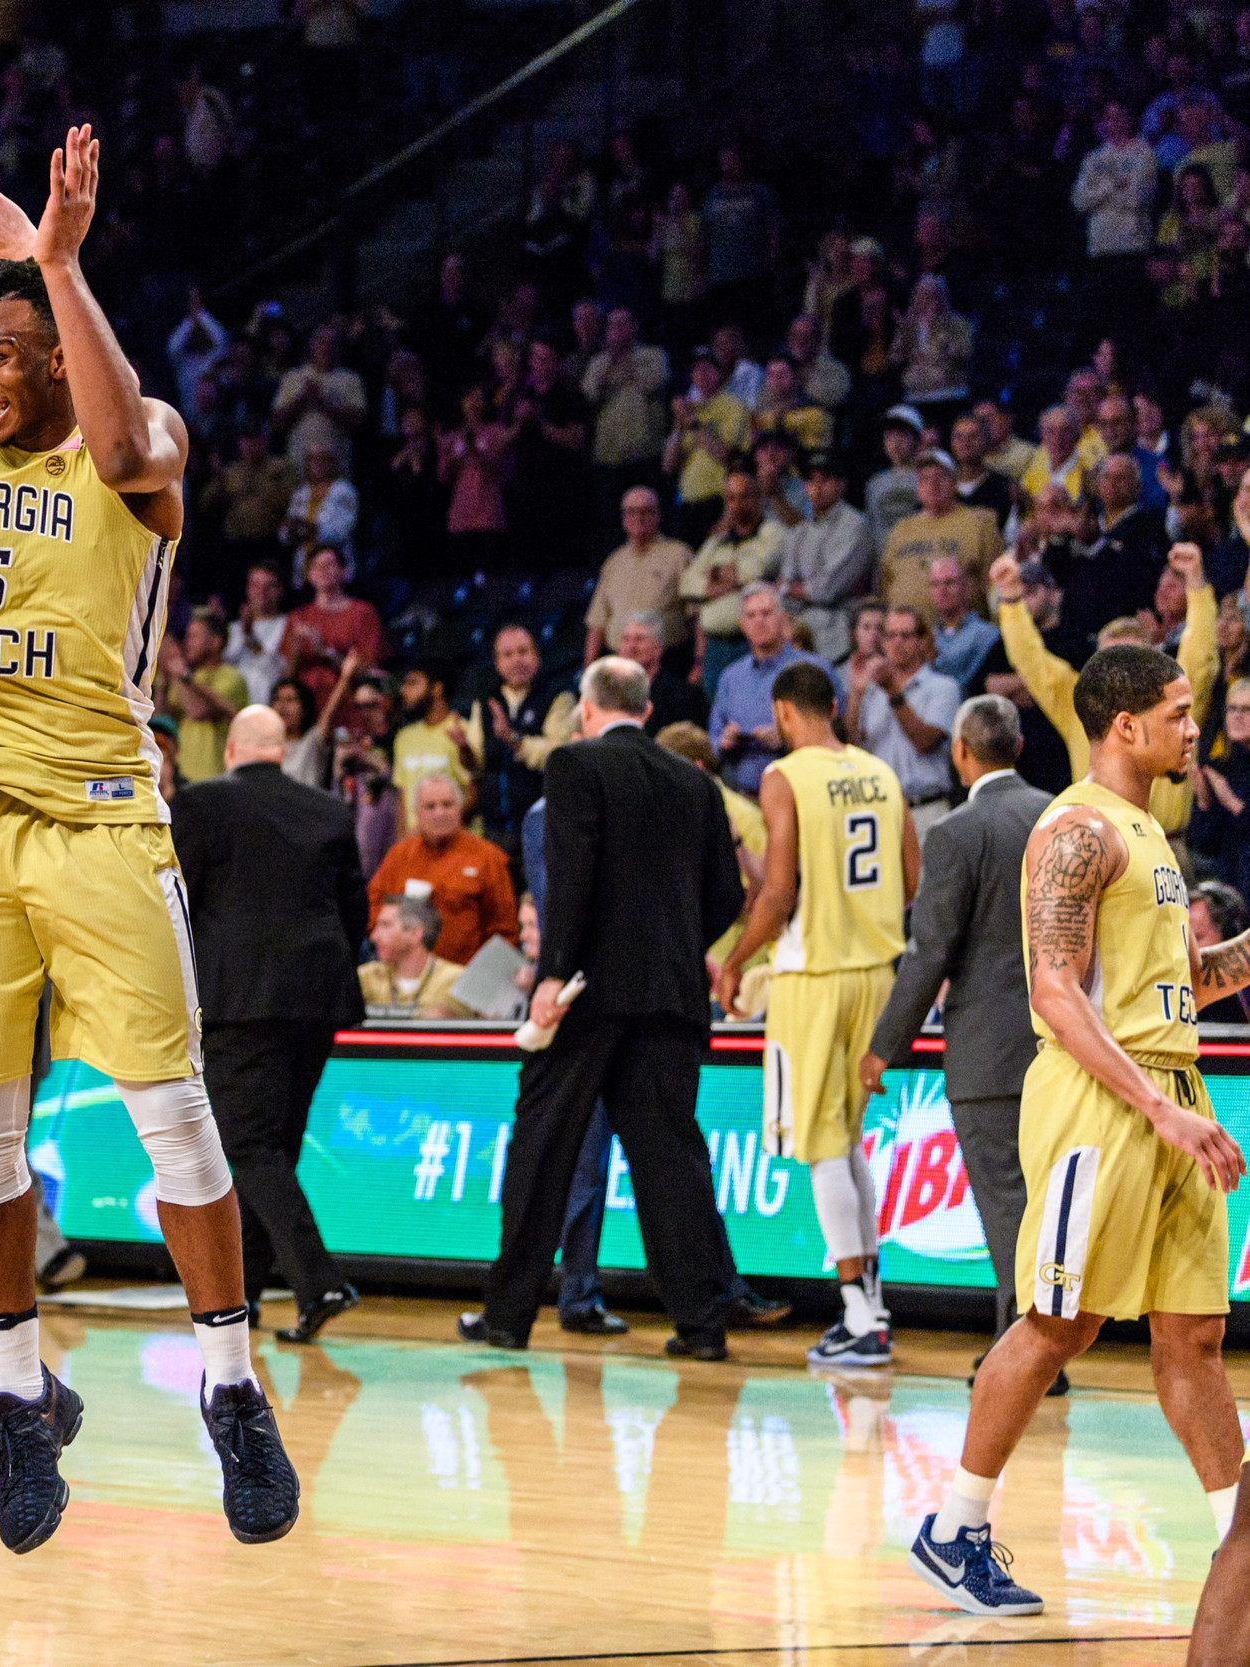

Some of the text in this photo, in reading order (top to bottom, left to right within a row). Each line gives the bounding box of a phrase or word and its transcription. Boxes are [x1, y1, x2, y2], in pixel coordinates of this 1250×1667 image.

[827, 776, 887, 806] PRICE
[844, 811, 881, 892] 2
[413, 1111, 472, 1203] #1
[1039, 1262, 1082, 1292] GT
